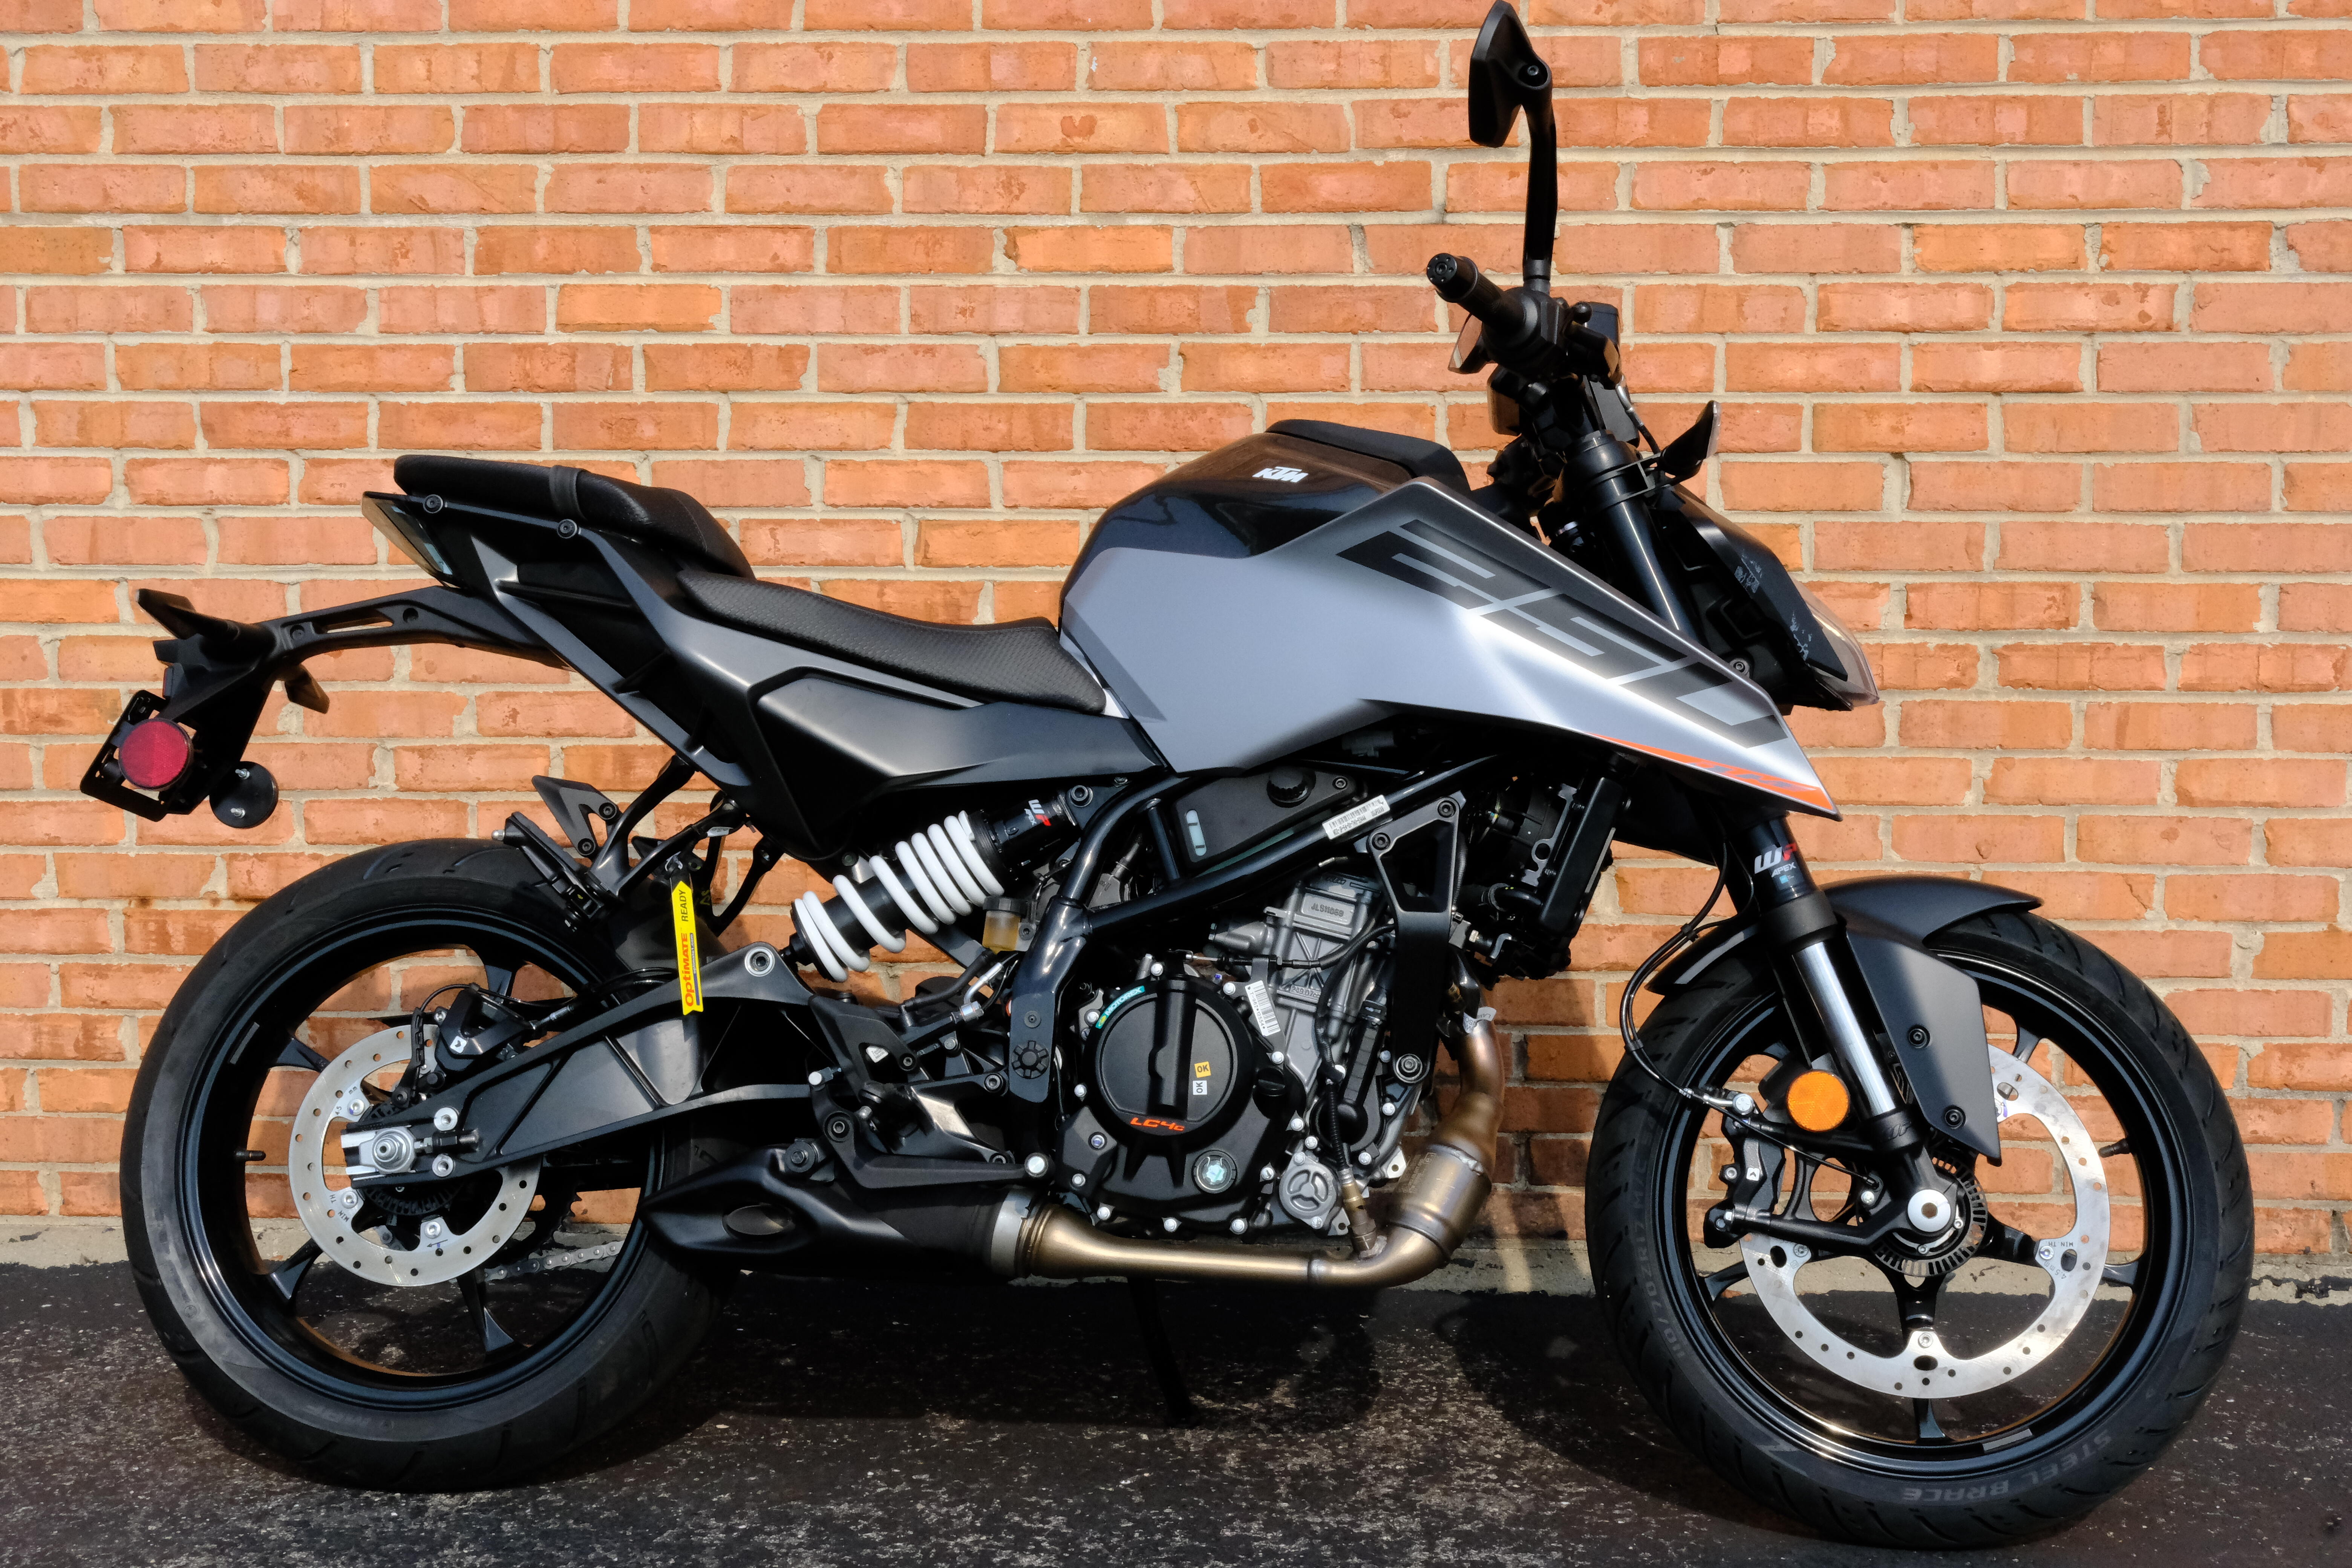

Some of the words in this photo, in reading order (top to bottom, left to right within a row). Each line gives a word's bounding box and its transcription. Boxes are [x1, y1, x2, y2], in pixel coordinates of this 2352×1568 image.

[1253, 467, 1308, 483] KTM
[1024, 808, 1037, 826] APEX
[1029, 799, 1051, 826] WP
[1754, 843, 1797, 874] WP
[1772, 863, 1796, 877] APEX
[679, 890, 688, 922] READY
[1105, 986, 1142, 1015] MOTOREX
[1196, 1082, 1203, 1093] OK
[329, 1194, 336, 1204] TH
[338, 1210, 349, 1222] MIN
[2021, 1429, 2113, 1486] STEEL
[1902, 1480, 2009, 1503] BRACE
